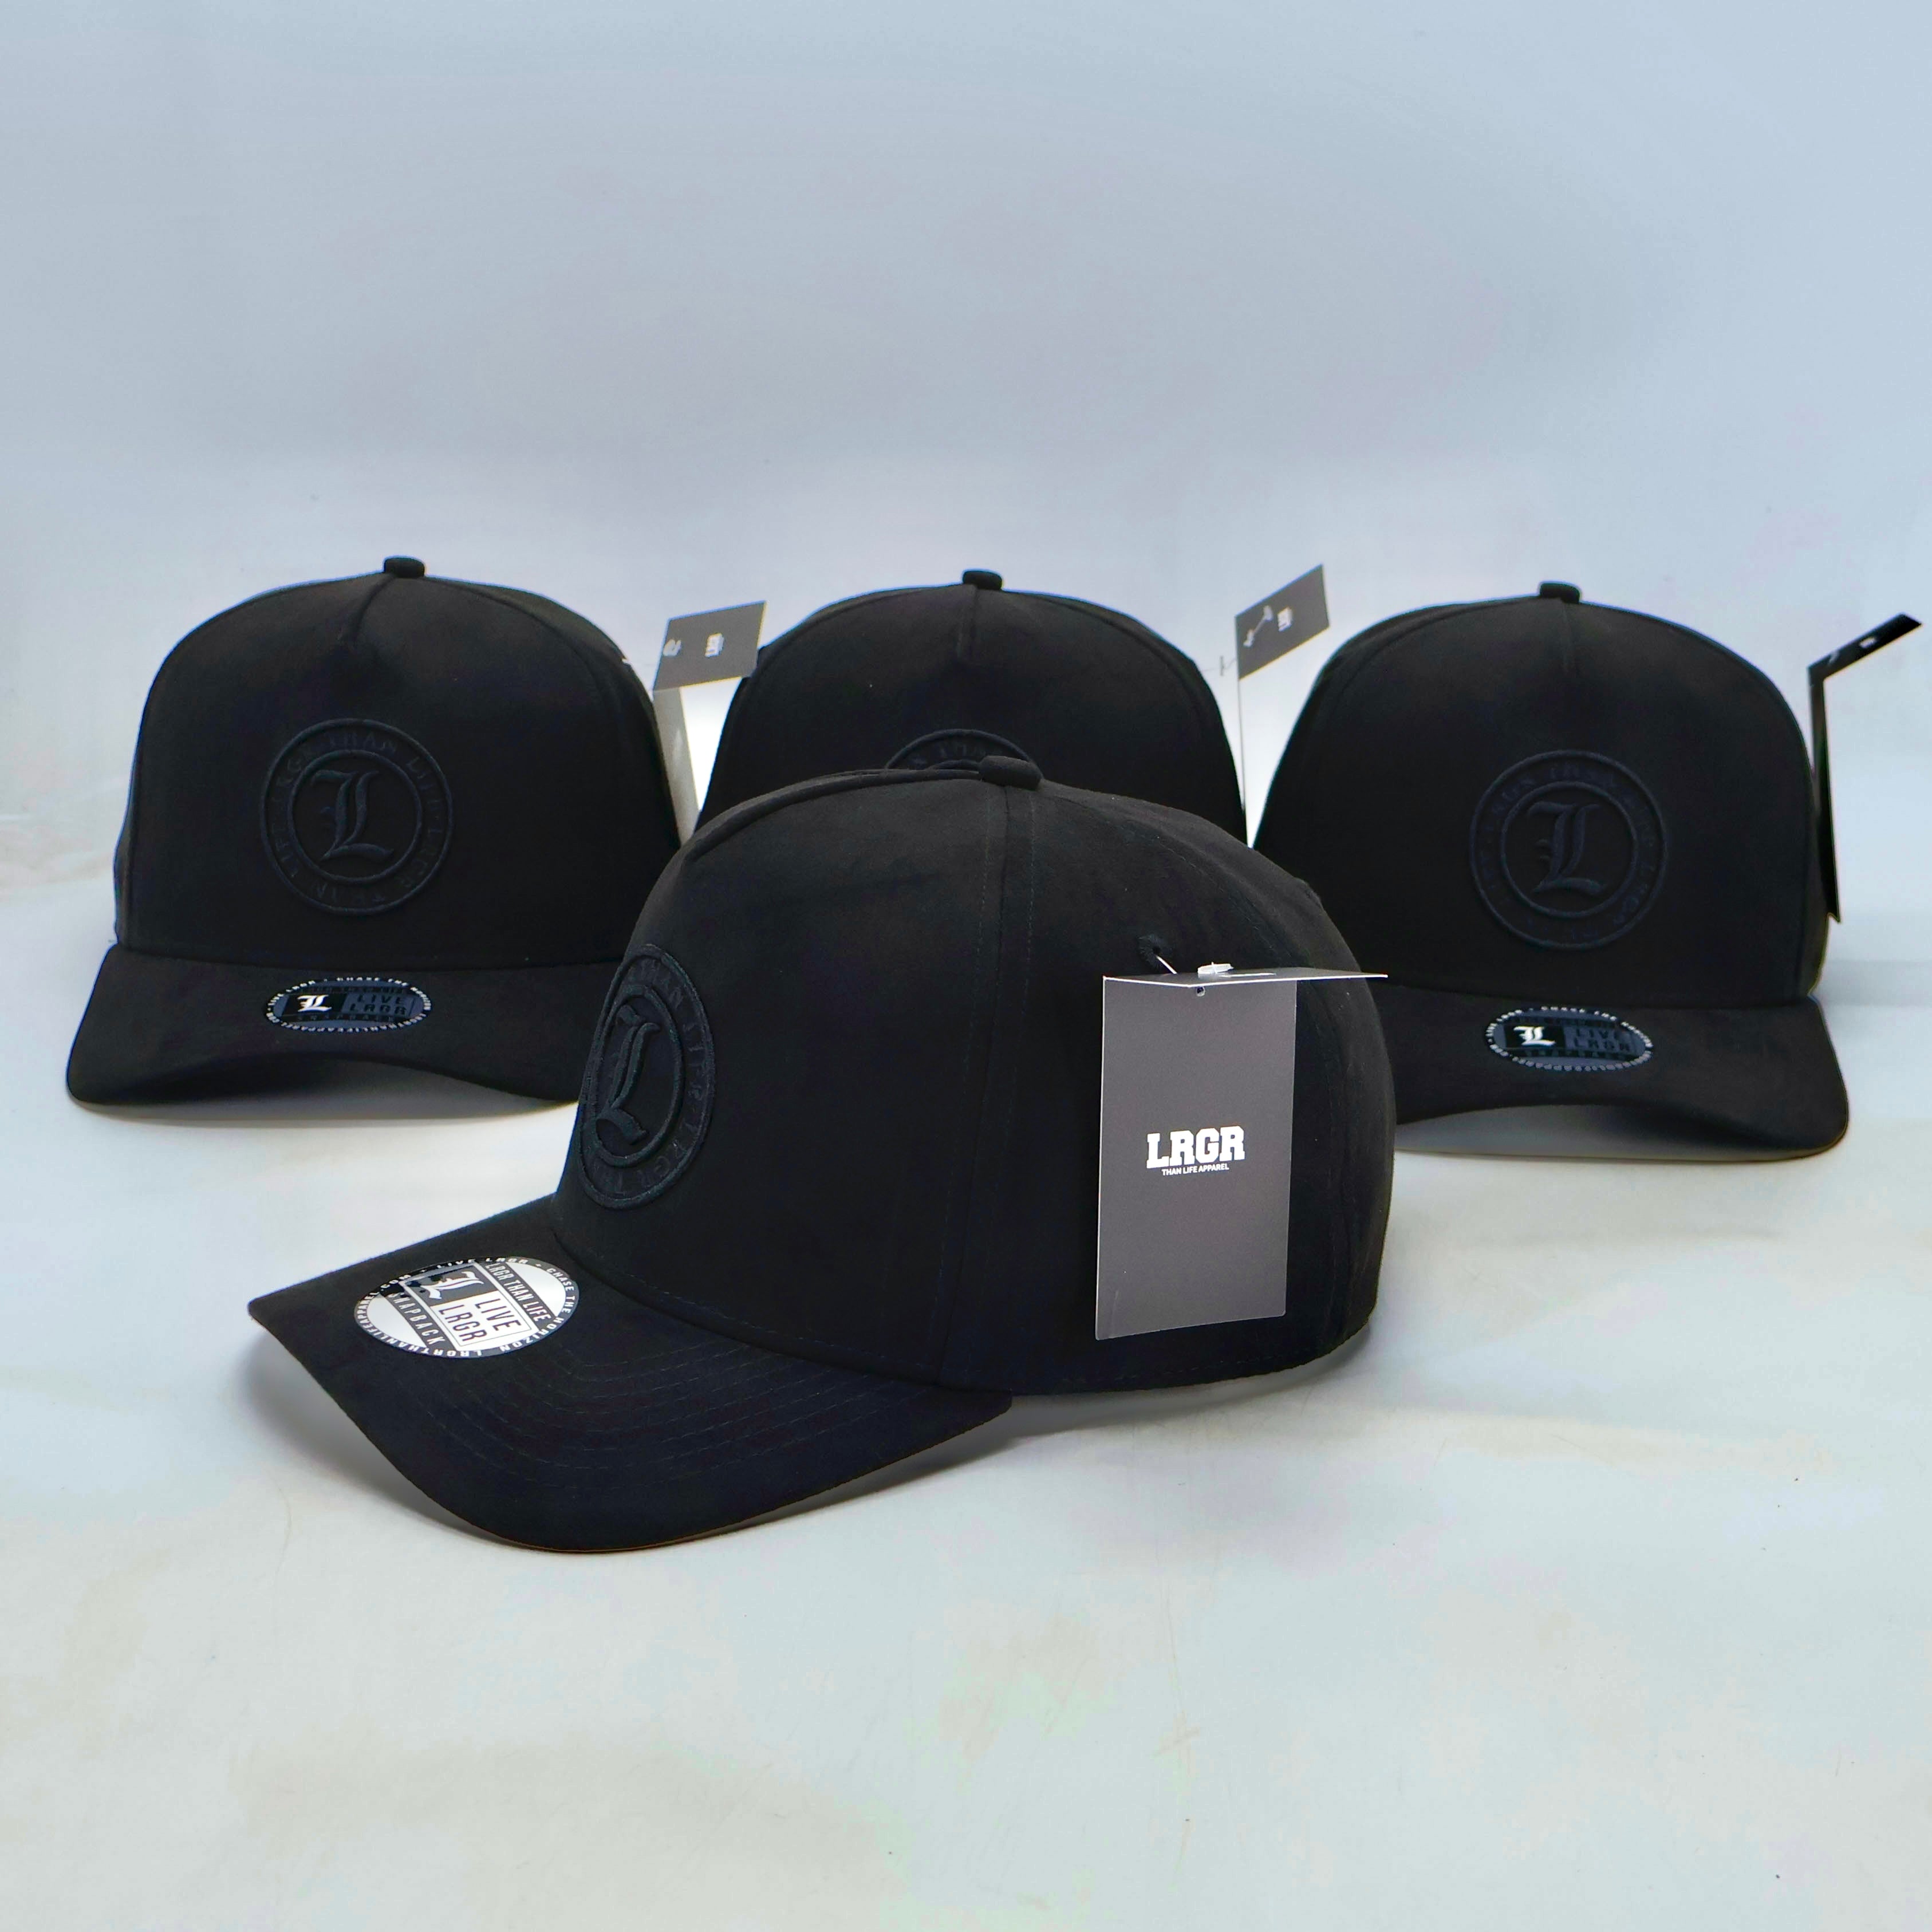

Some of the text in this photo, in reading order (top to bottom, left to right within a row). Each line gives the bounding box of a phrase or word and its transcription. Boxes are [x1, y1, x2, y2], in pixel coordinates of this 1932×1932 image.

[310, 769, 395, 864] L
[1525, 801, 1608, 897] L
[297, 993, 333, 1012] L
[1513, 1025, 1558, 1046] L
[1146, 1125, 1245, 1169] LRGR
[1161, 1163, 1230, 1176] THAN LIFE APPAREL
[486, 1263, 552, 1322] LRGR THAN LIFE
[546, 1267, 575, 1291] CHASE
[388, 1292, 446, 1345] SNAPBACK
[475, 1298, 522, 1332] LIVE
[563, 1295, 575, 1314] THE
[439, 1304, 488, 1342] LRGR
[499, 1316, 565, 1352] HORIZON
